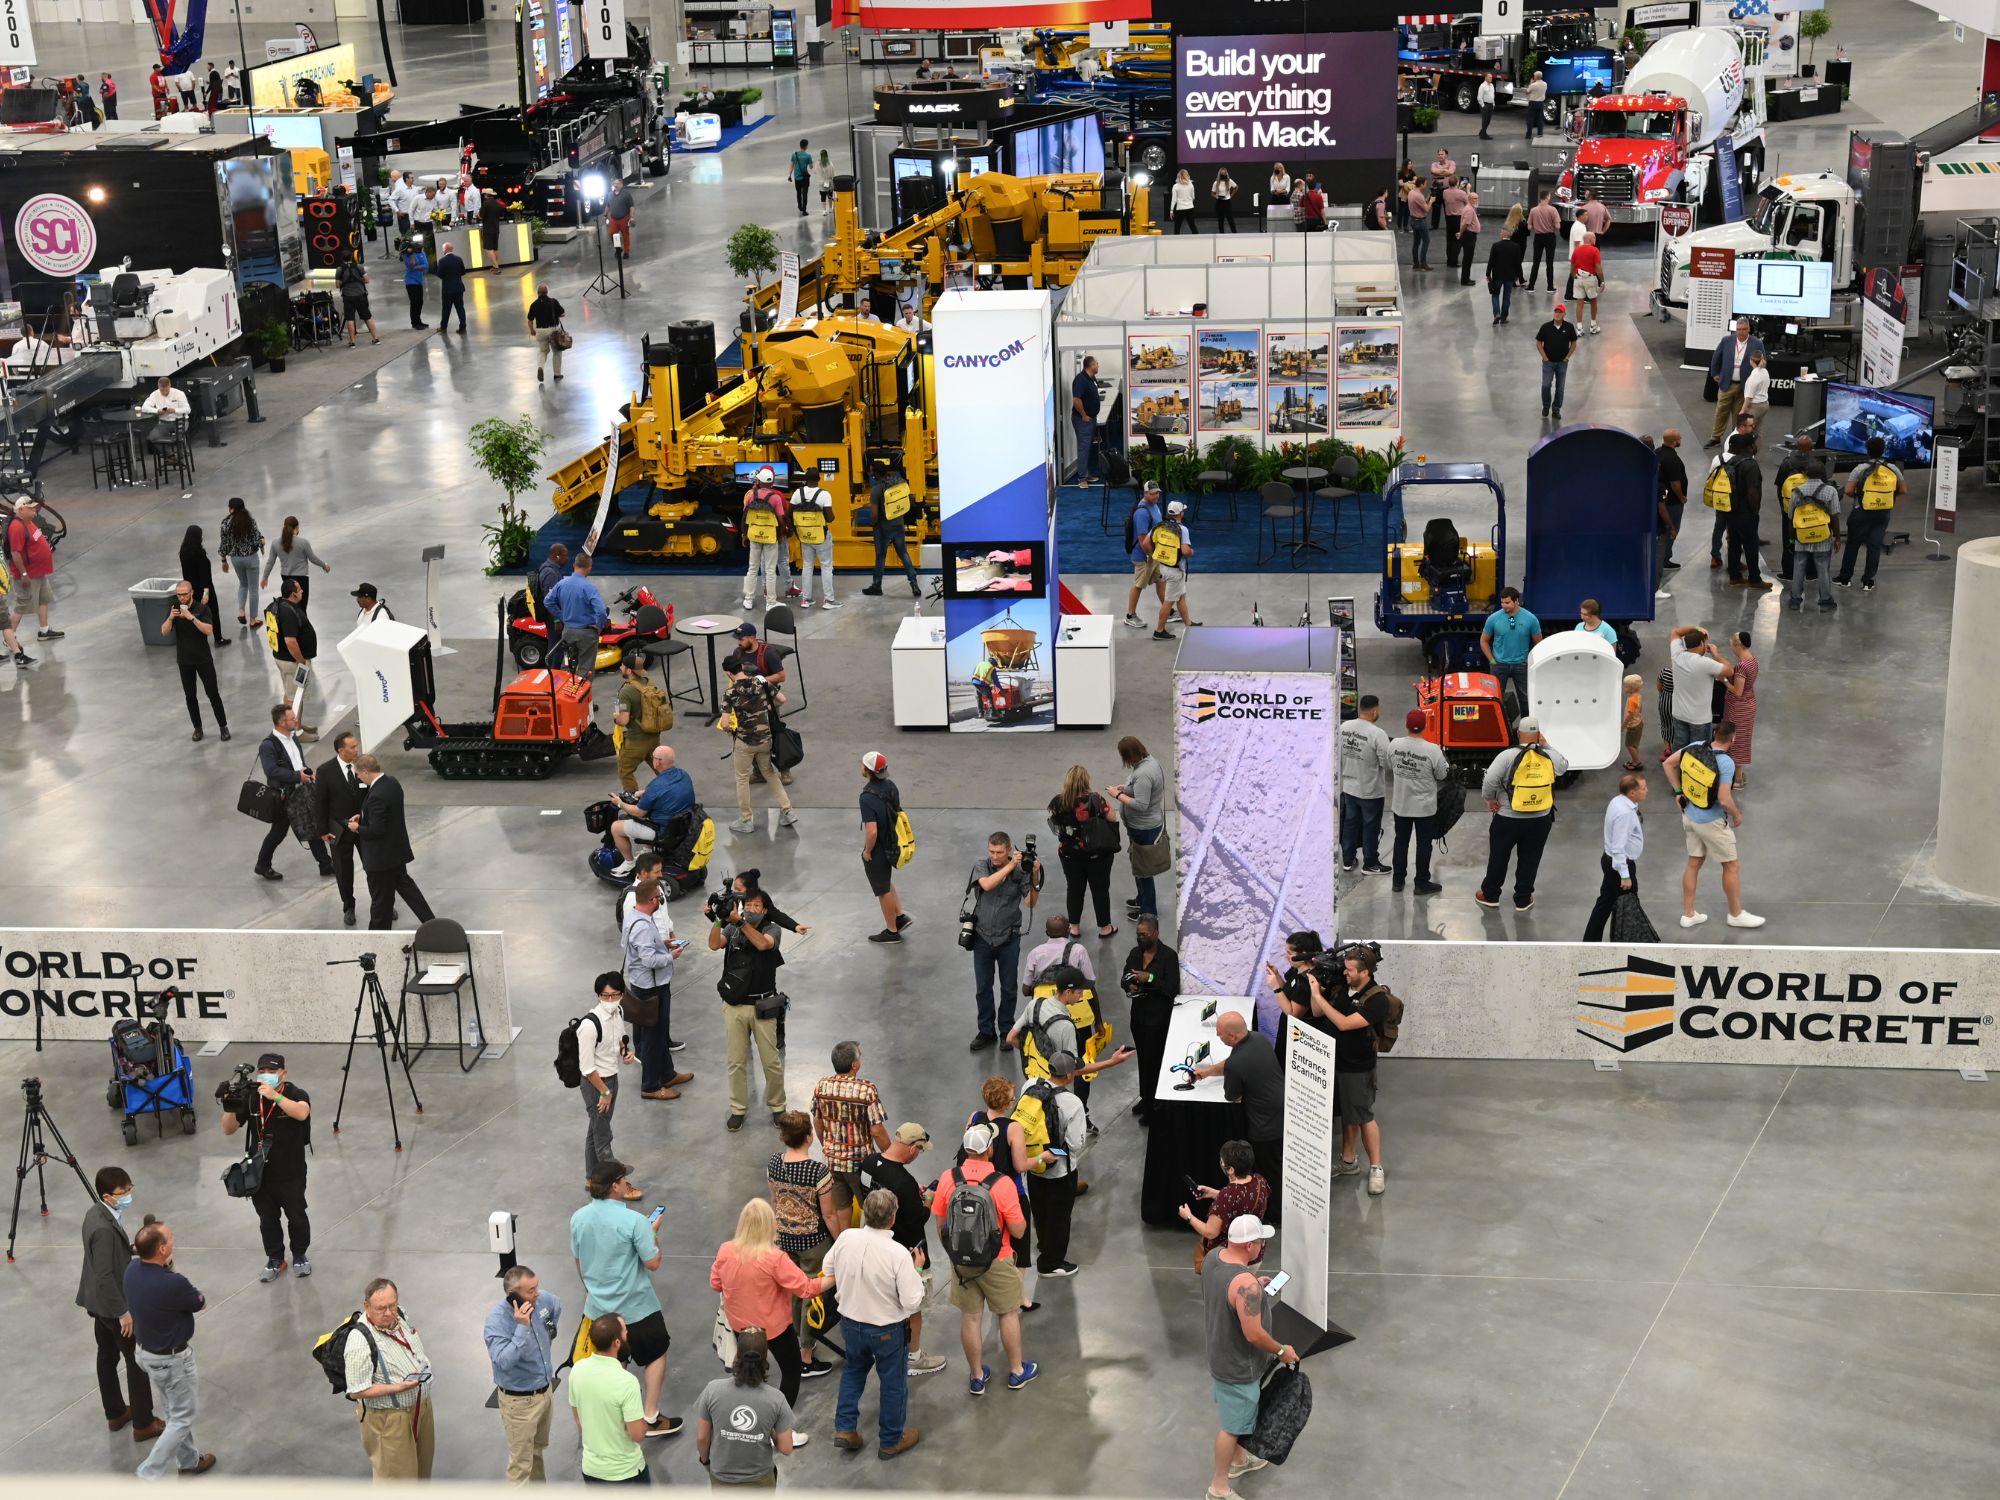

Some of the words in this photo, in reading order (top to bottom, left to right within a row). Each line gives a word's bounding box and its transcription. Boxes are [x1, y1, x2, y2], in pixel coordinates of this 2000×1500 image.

[1186, 48, 1256, 77] Build
[1260, 52, 1326, 82] your
[909, 104, 960, 113] MACK
[1186, 84, 1331, 117] everything
[1186, 120, 1246, 149] with
[1252, 119, 1336, 148] Mack.
[30, 218, 80, 254] SCI
[944, 340, 1024, 368] CANYCOM
[375, 670, 389, 703] CANYCOM
[1218, 691, 1286, 705] WORLD
[1293, 696, 1313, 705] OF
[1218, 706, 1322, 720] CONCRETE
[1454, 706, 1475, 716] NEW
[0, 946, 132, 980] ORLD
[148, 958, 198, 979] OF
[1680, 965, 1882, 1003] WORLD
[1899, 981, 1958, 1005] OF
[1300, 1030, 1320, 1046] WORLD
[1679, 1005, 1982, 1046] CONCRETE
[1300, 1036, 1330, 1058] CONCRETE
[1291, 1061, 1327, 1089] Scanning
[1293, 1050, 1327, 1076] Entrance
